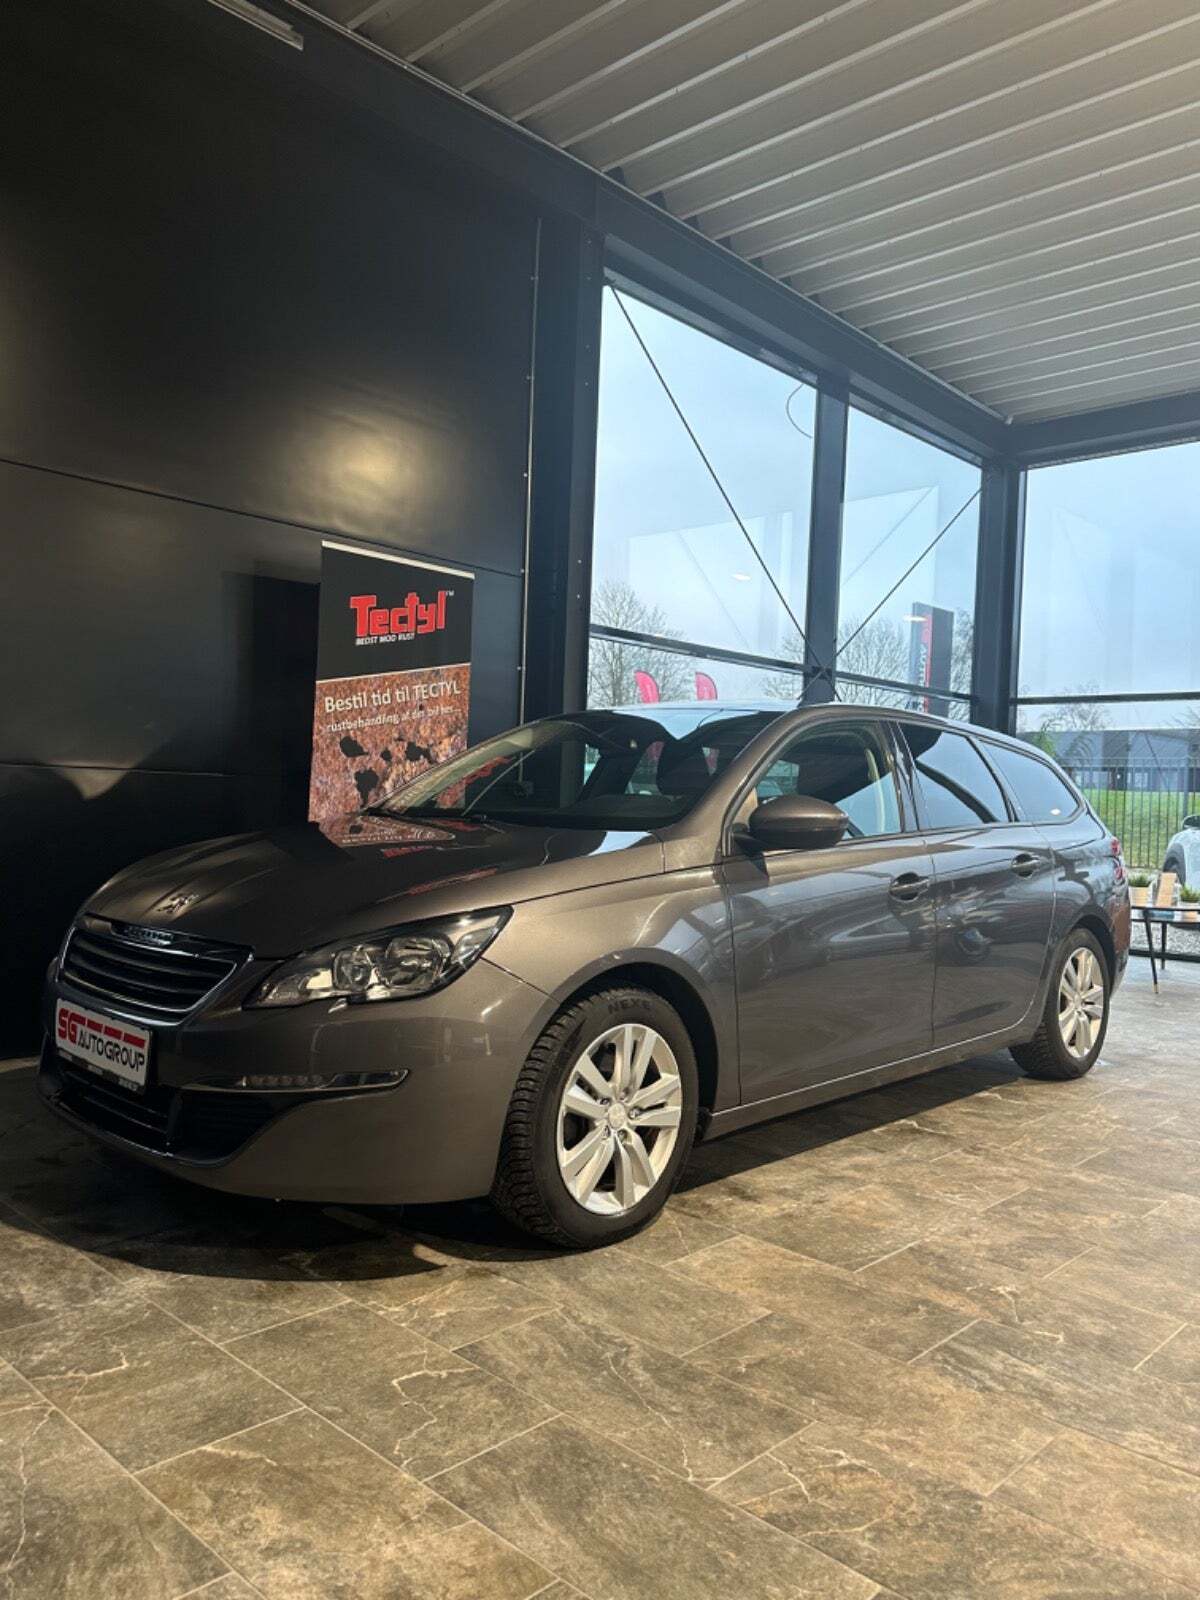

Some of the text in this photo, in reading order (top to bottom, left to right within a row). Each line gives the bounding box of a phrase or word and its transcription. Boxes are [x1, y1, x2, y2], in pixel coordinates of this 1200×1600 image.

[350, 590, 446, 637] Tectyl
[325, 681, 461, 713] Bestil tid til TECTYL
[58, 1007, 86, 1046] SG
[77, 1029, 145, 1073] AUTOGROUP
